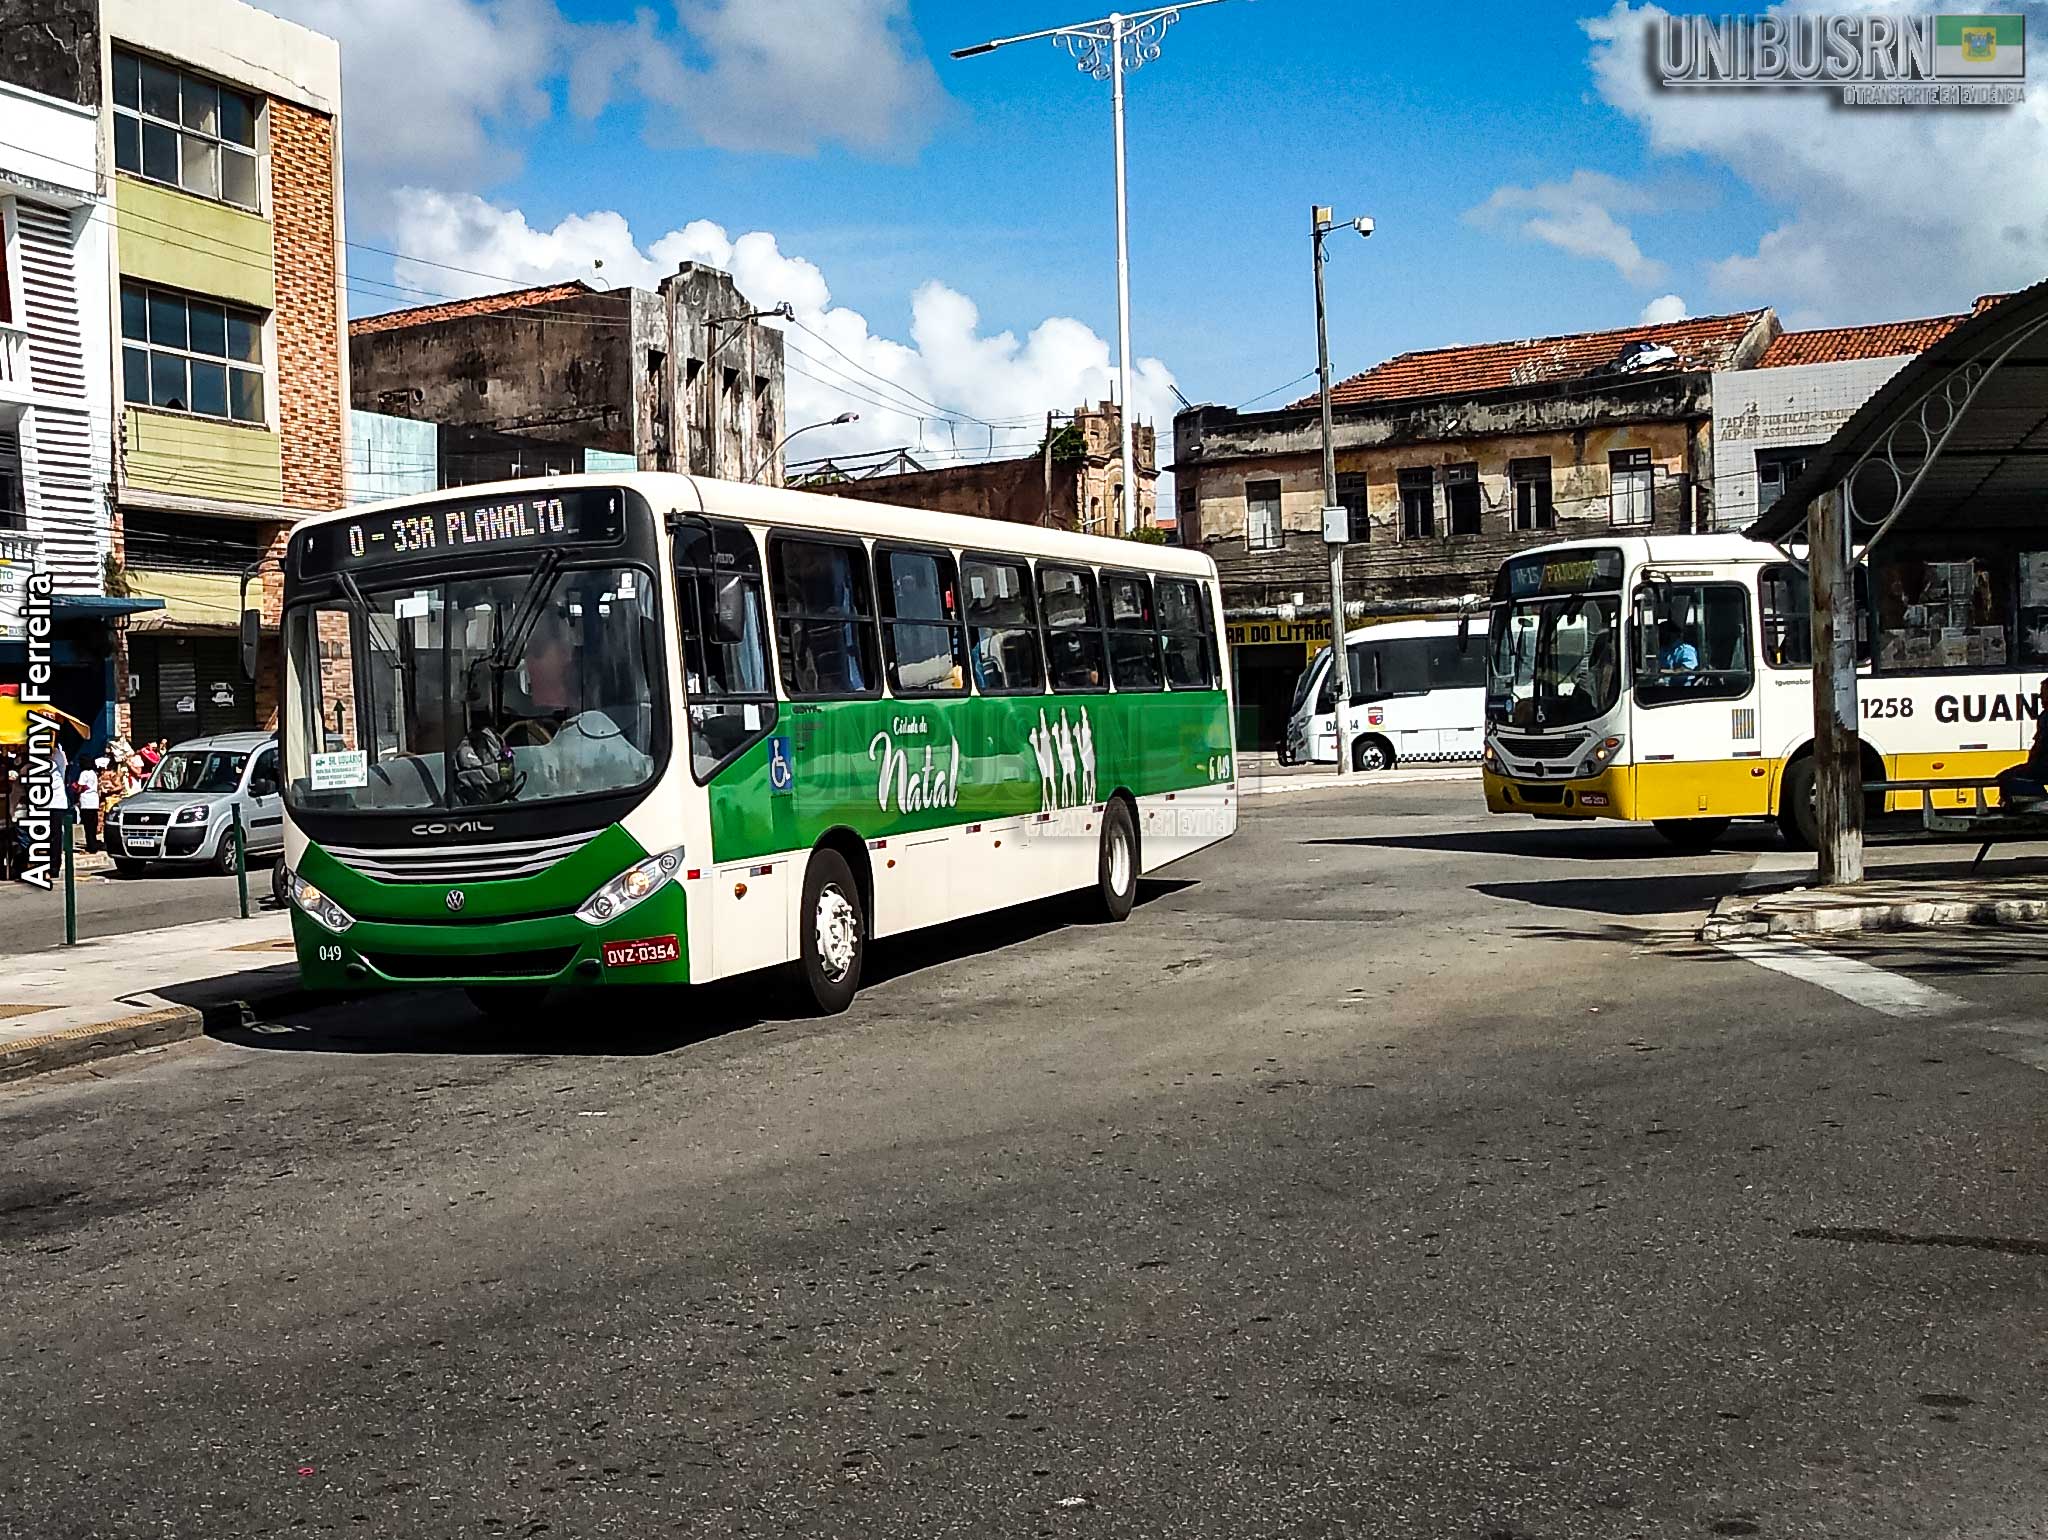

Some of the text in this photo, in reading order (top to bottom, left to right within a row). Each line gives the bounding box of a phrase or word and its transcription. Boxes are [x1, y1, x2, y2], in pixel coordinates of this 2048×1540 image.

[391, 515, 437, 552] 33A
[445, 500, 565, 545] PLANALTO
[1251, 625, 1271, 642] DO
[1860, 697, 1914, 719] 1258
[869, 731, 959, 814] Natal
[411, 821, 494, 835] COMIL
[319, 945, 342, 961] 049
